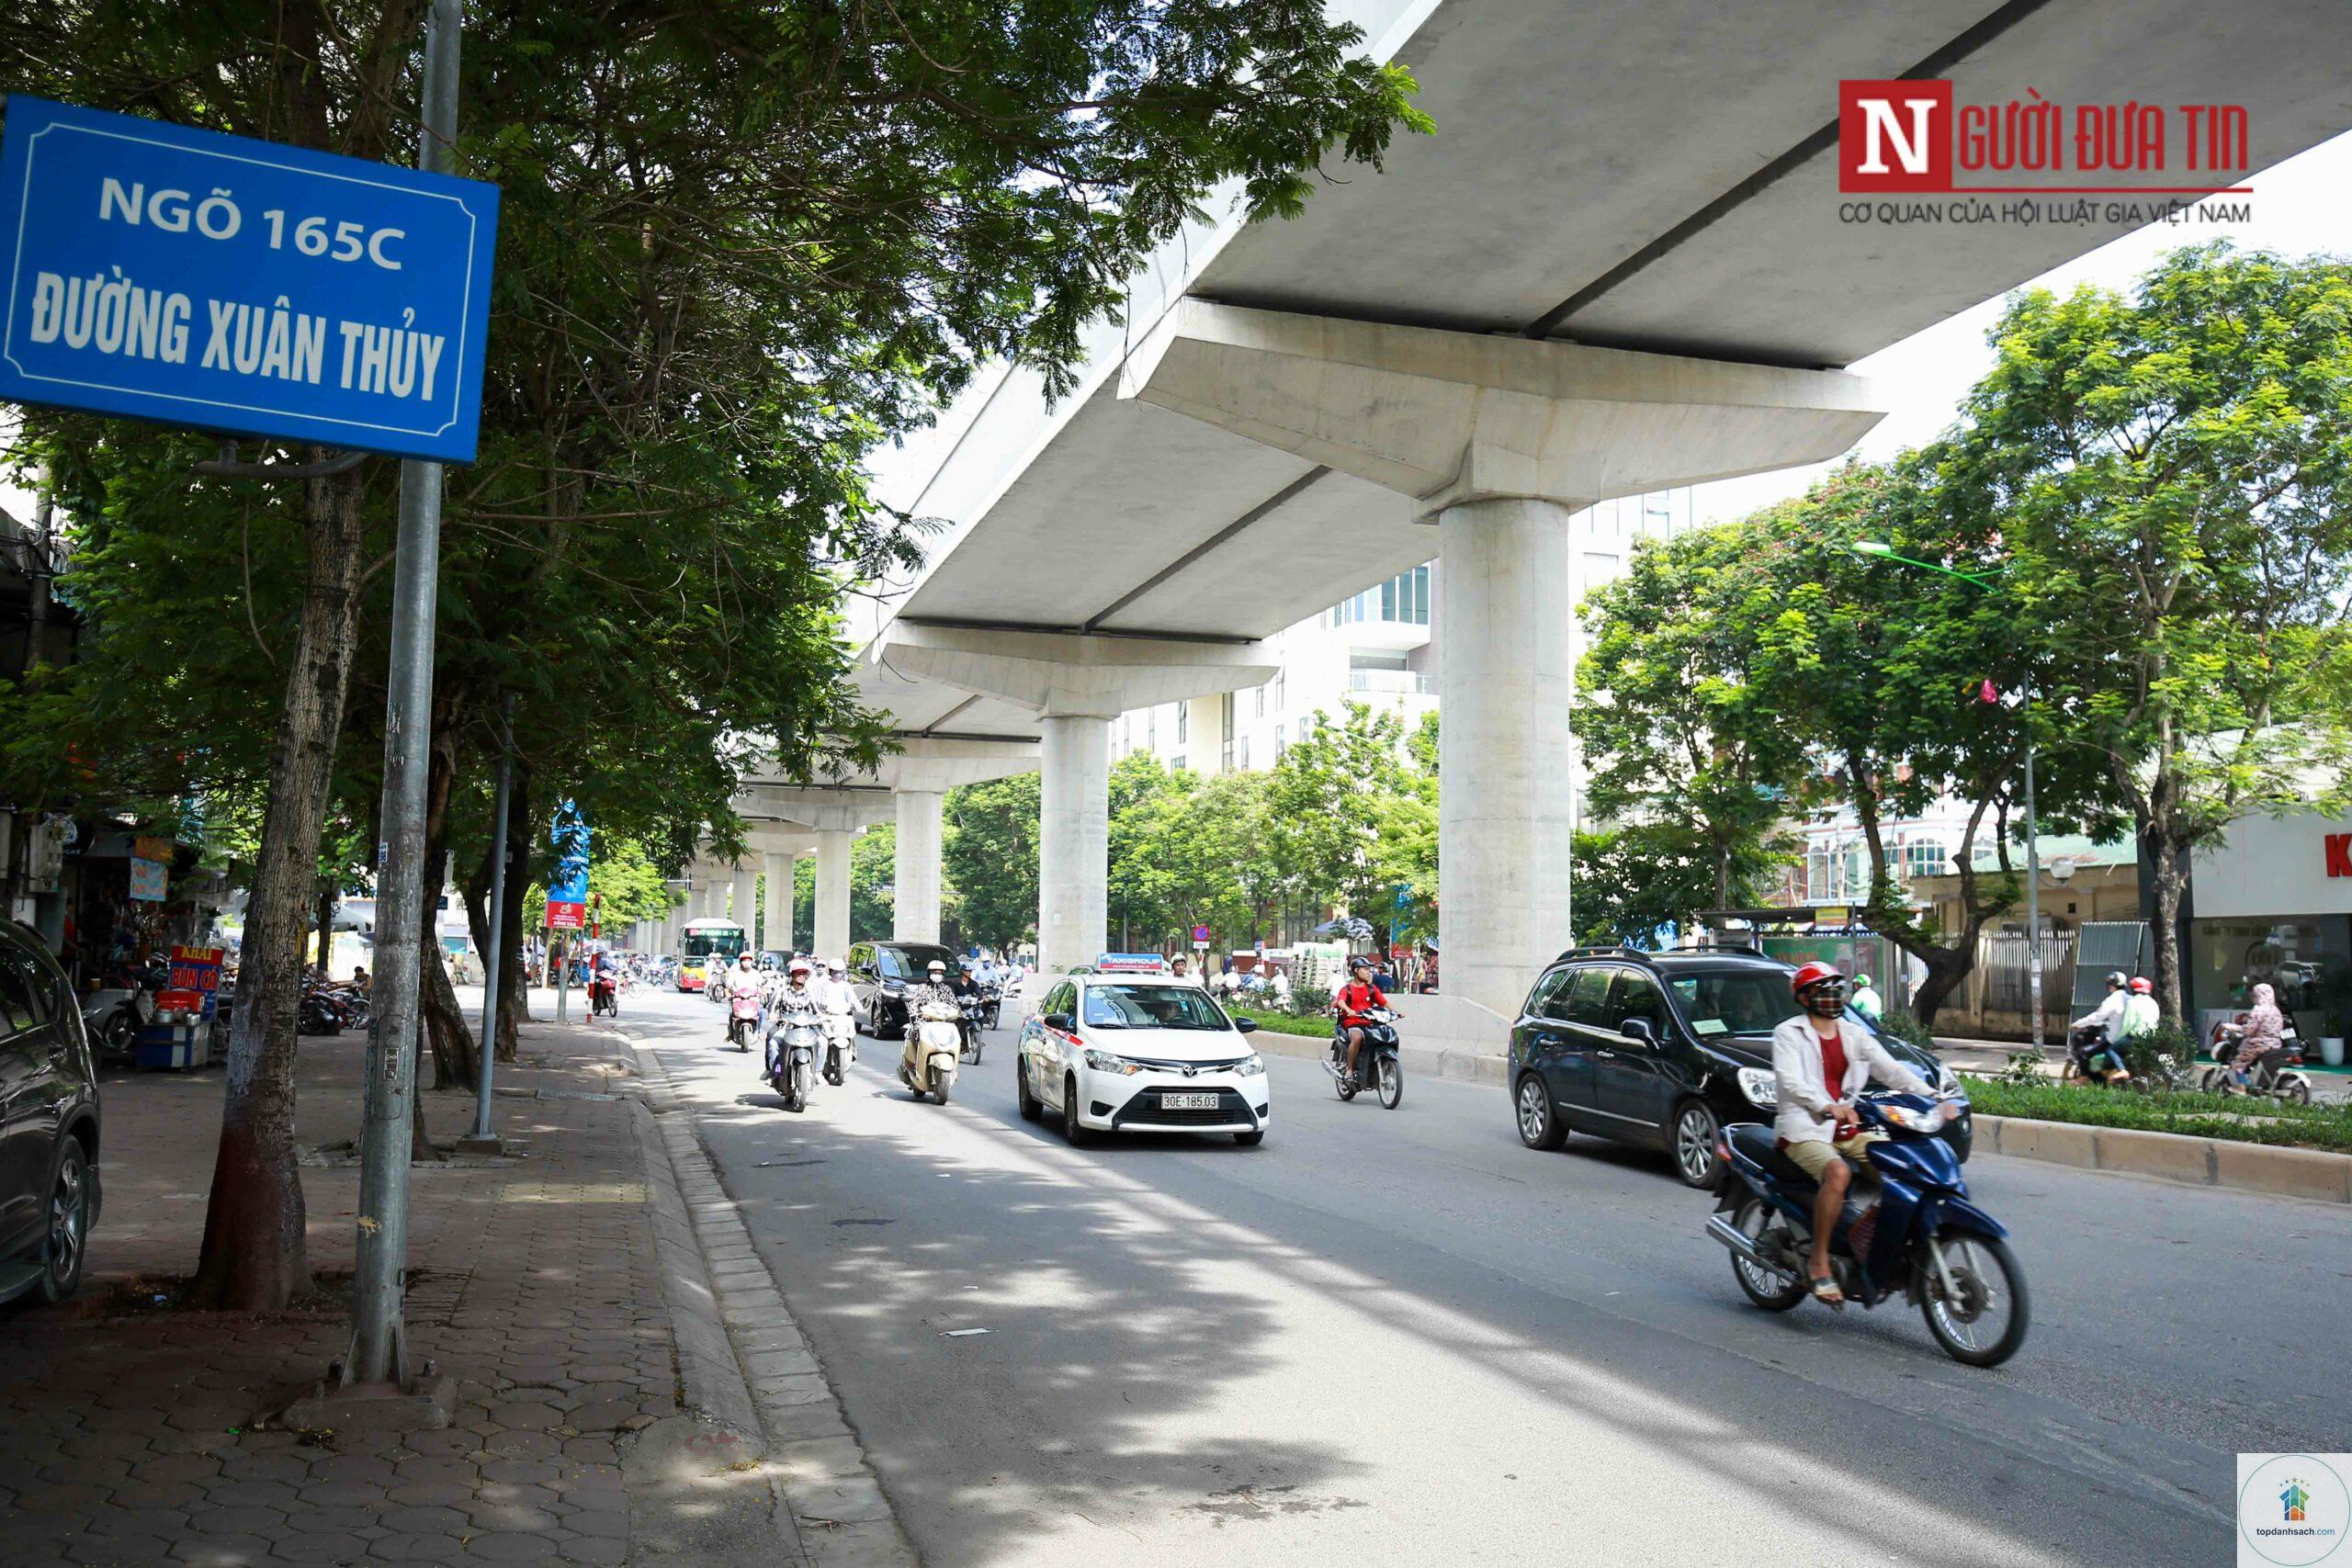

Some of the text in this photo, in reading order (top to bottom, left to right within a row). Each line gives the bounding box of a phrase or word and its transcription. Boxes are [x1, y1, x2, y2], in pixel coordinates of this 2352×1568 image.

[98, 177, 406, 270] NGÕ 165C
[30, 265, 446, 401] ĐƯỜNG XUÂN THỦY
